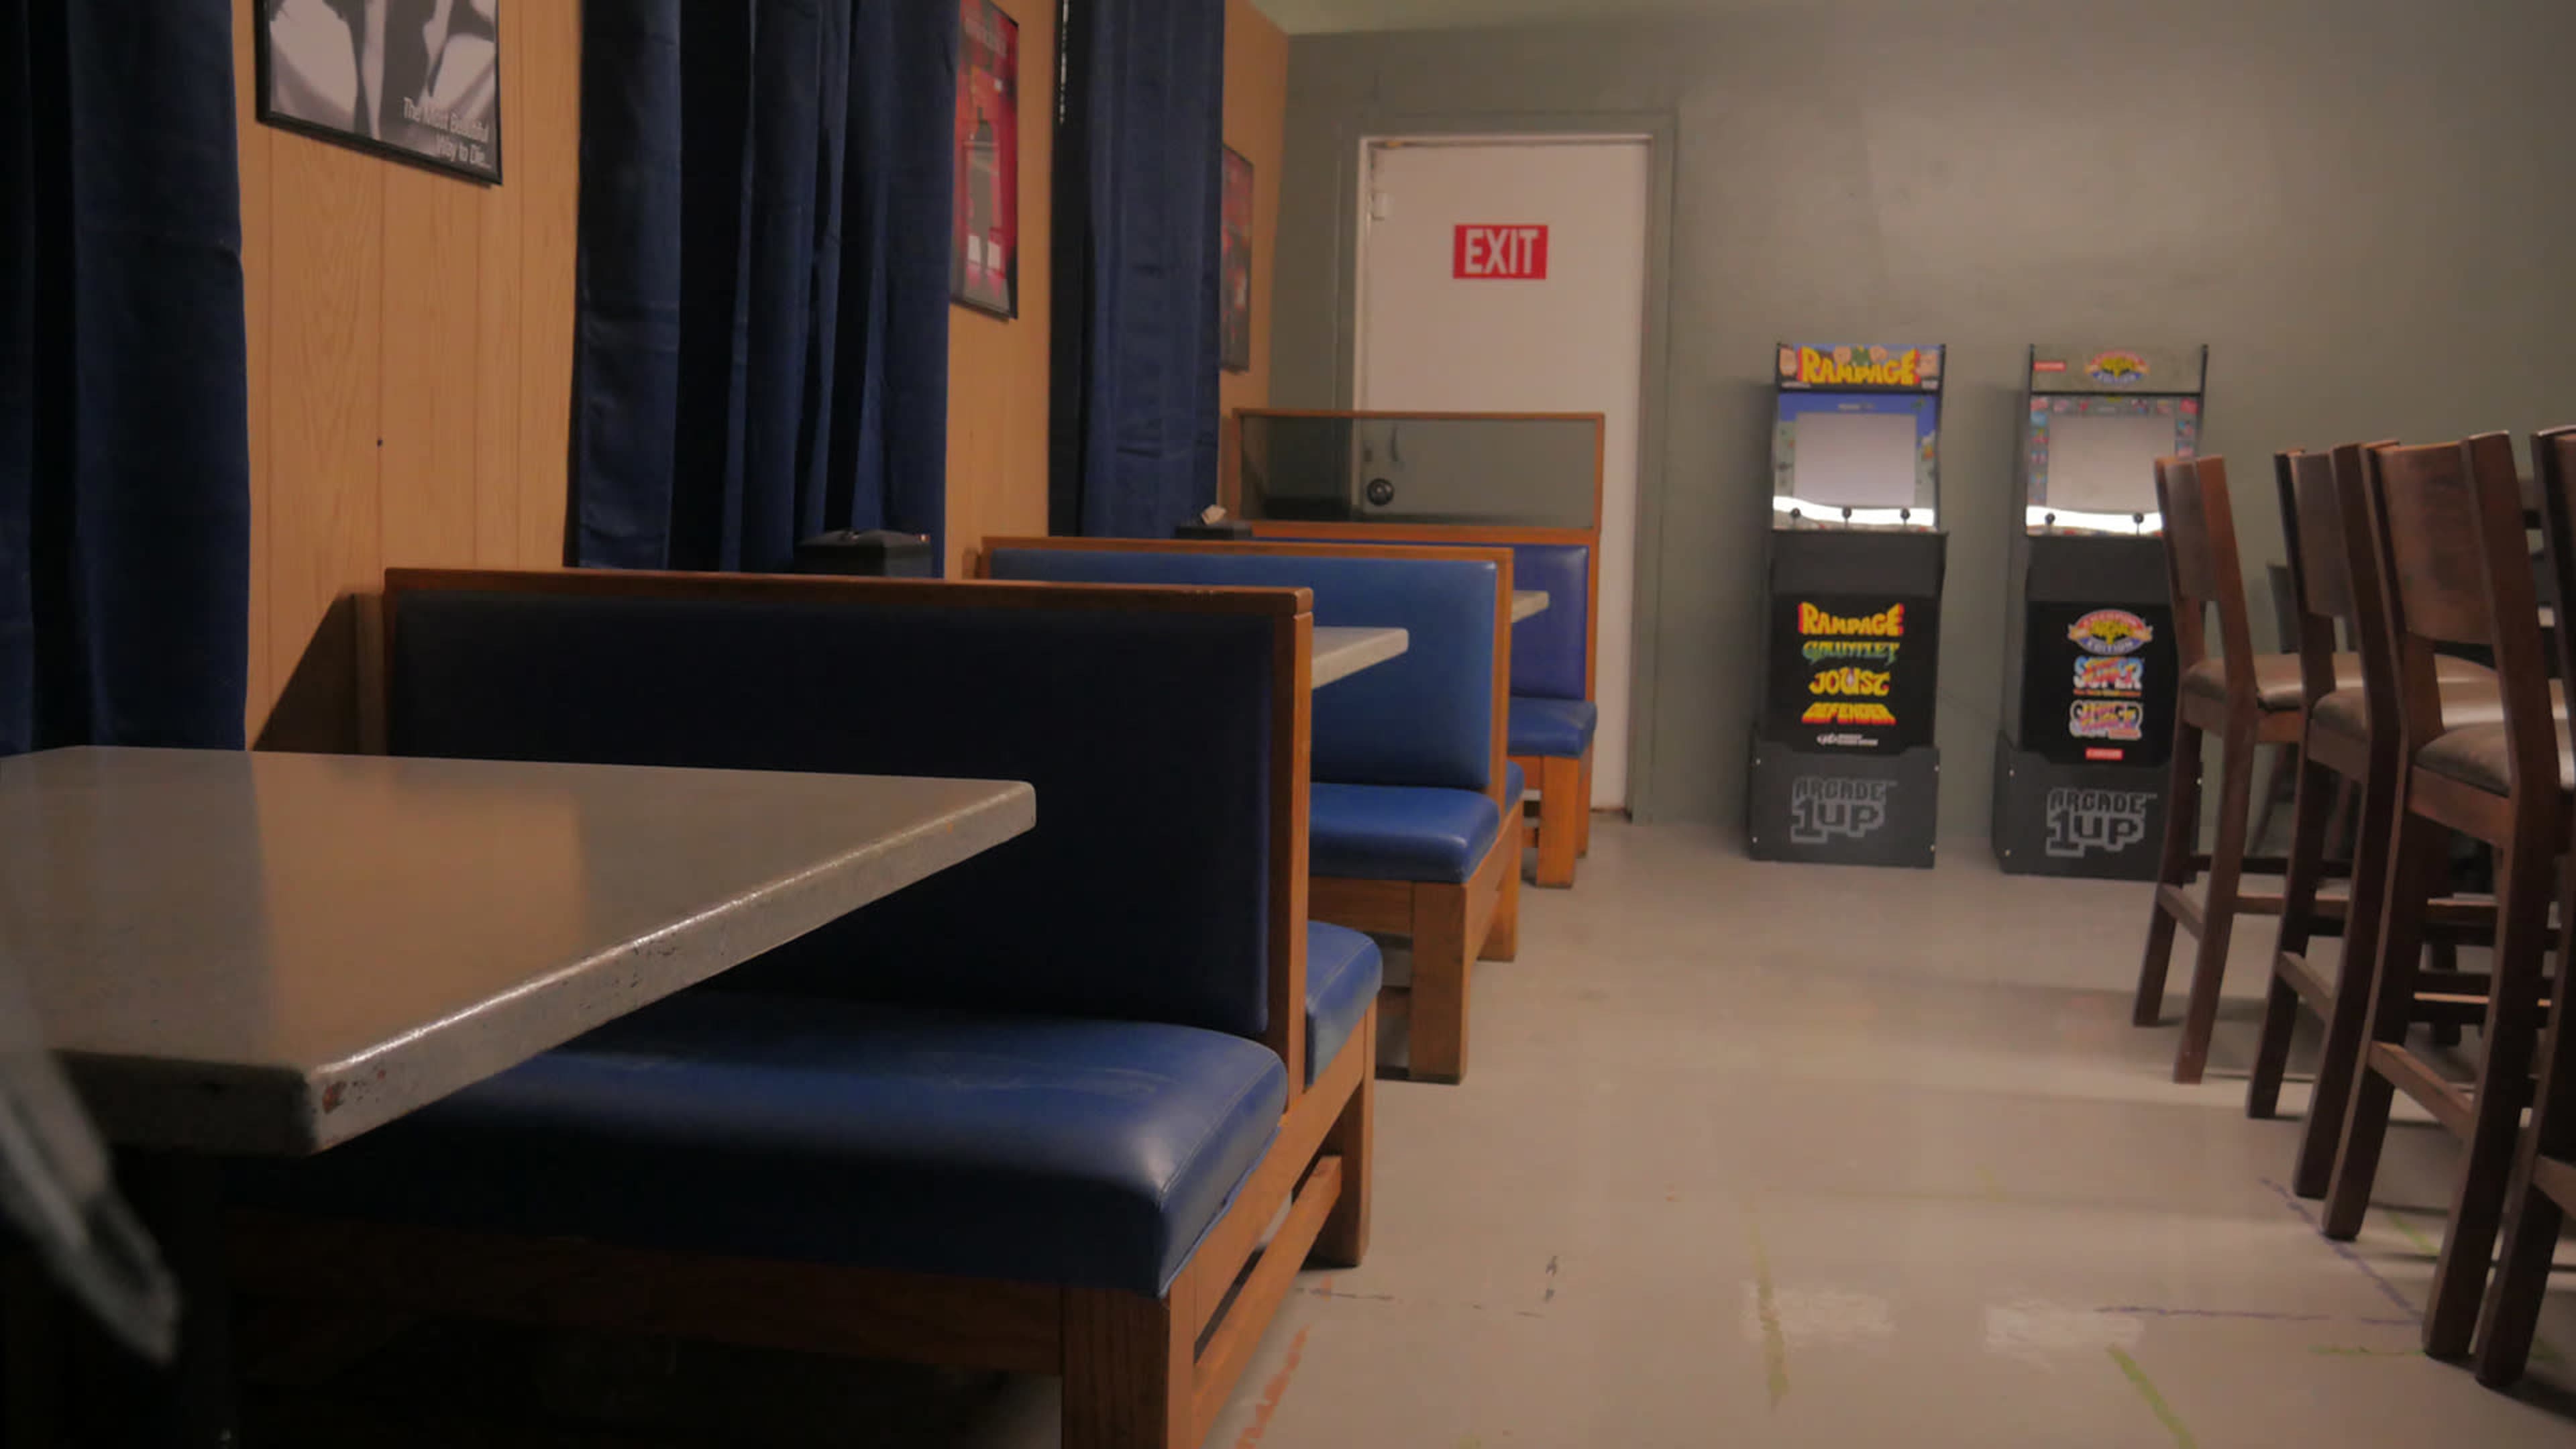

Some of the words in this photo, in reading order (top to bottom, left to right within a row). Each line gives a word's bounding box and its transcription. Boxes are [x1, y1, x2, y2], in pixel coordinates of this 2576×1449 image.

[403, 97, 421, 123] The
[436, 133, 458, 162] Way
[459, 143, 468, 162] to
[1464, 228, 1540, 274] EXIT
[1796, 345, 1921, 386] RAMPAGE
[1798, 602, 1905, 637] RAMPAGE
[1802, 641, 1900, 665] GAUNTLET
[1809, 667, 1890, 696] JOUST
[1801, 702, 1897, 725] DEFENDER
[1793, 776, 1886, 802] ARCADE
[2047, 788, 2147, 814] ARCADE
[1792, 798, 1885, 843] 1UP
[2046, 810, 2145, 857] 1UP
